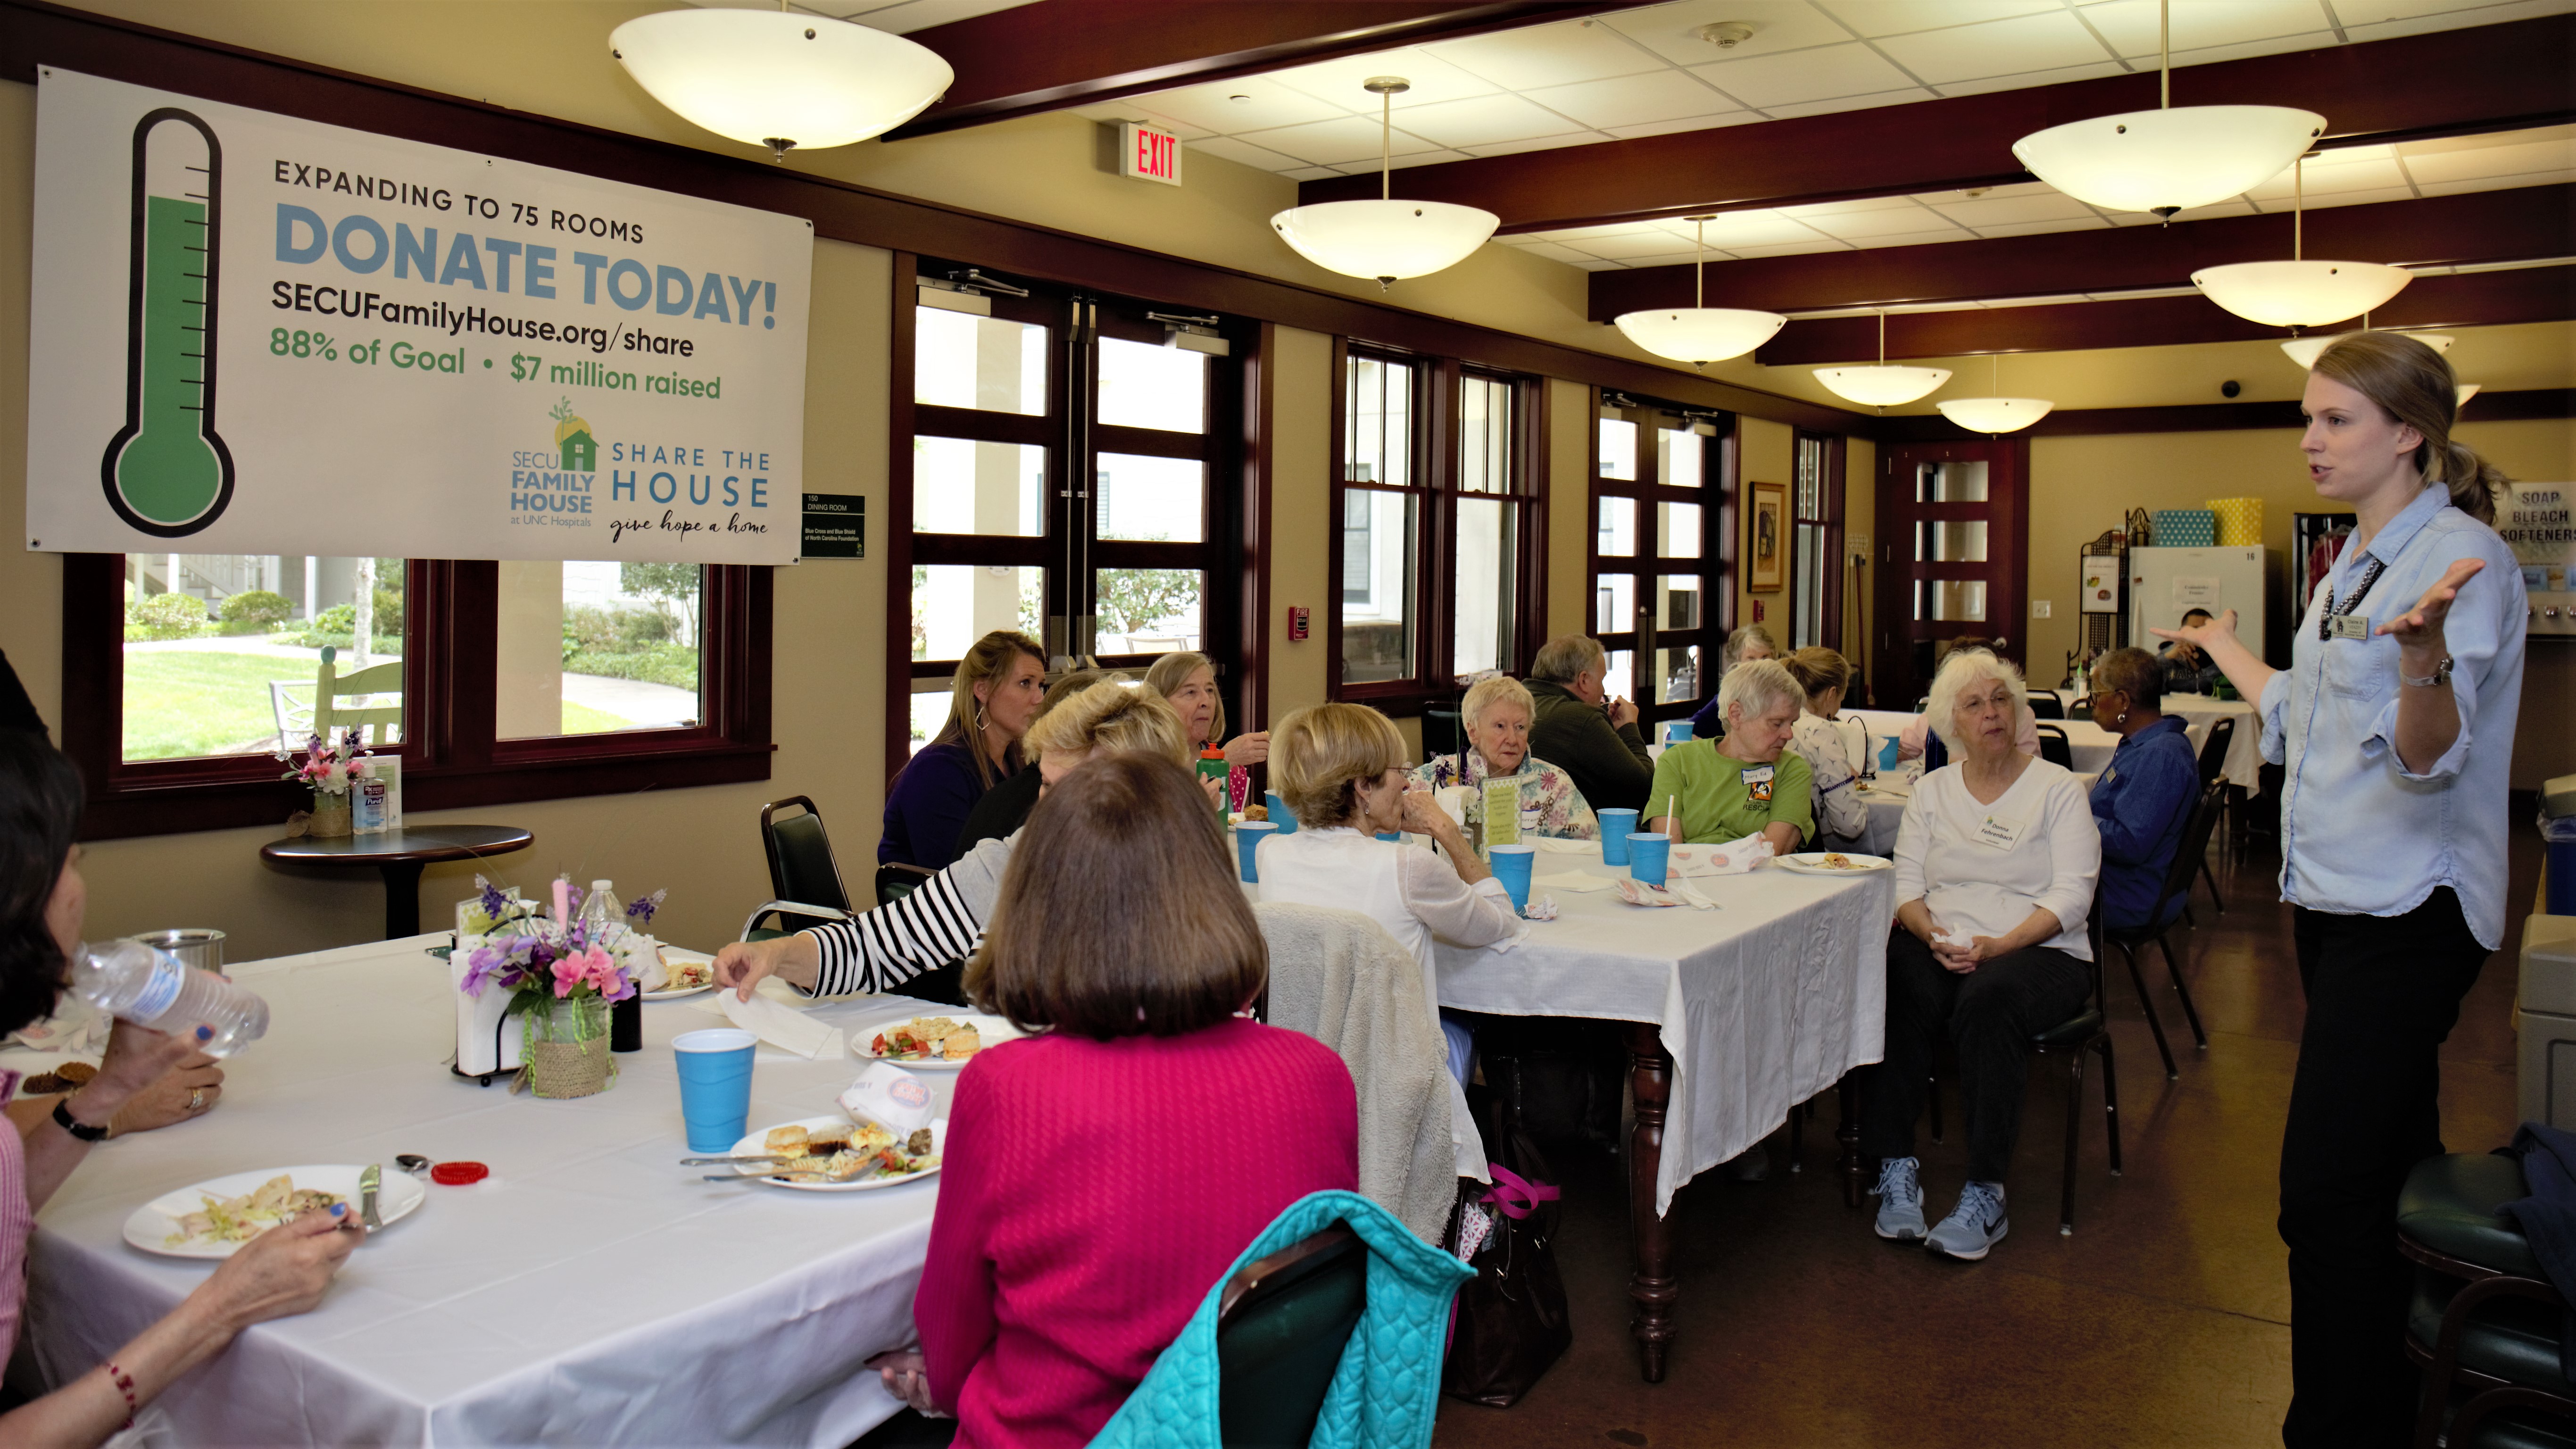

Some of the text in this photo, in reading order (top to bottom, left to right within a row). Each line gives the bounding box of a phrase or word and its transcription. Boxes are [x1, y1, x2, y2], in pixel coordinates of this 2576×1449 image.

[1138, 129, 1175, 179] EXIT
[275, 159, 643, 244] EXPANDING TO 75 ROOMS
[275, 202, 777, 330] DONATE TODAY!
[272, 281, 694, 357] SECUFamilyHouse.org/share
[270, 327, 721, 399] 88% of Goal $7 million raised
[512, 450, 559, 470] SECU
[612, 442, 769, 471] SHARE THE
[512, 471, 596, 492] FAMILY
[613, 469, 768, 508] HOUSE
[511, 492, 592, 514] HOUSE
[2522, 491, 2559, 504] SOAP
[511, 515, 591, 529] at UNC Hospitals
[610, 509, 768, 543] give hope a home
[2513, 510, 2568, 523] BLEACH
[2247, 553, 2255, 561] 16
[1981, 828, 2012, 841] Fehrenbach
[1992, 824, 2009, 832] Donna
